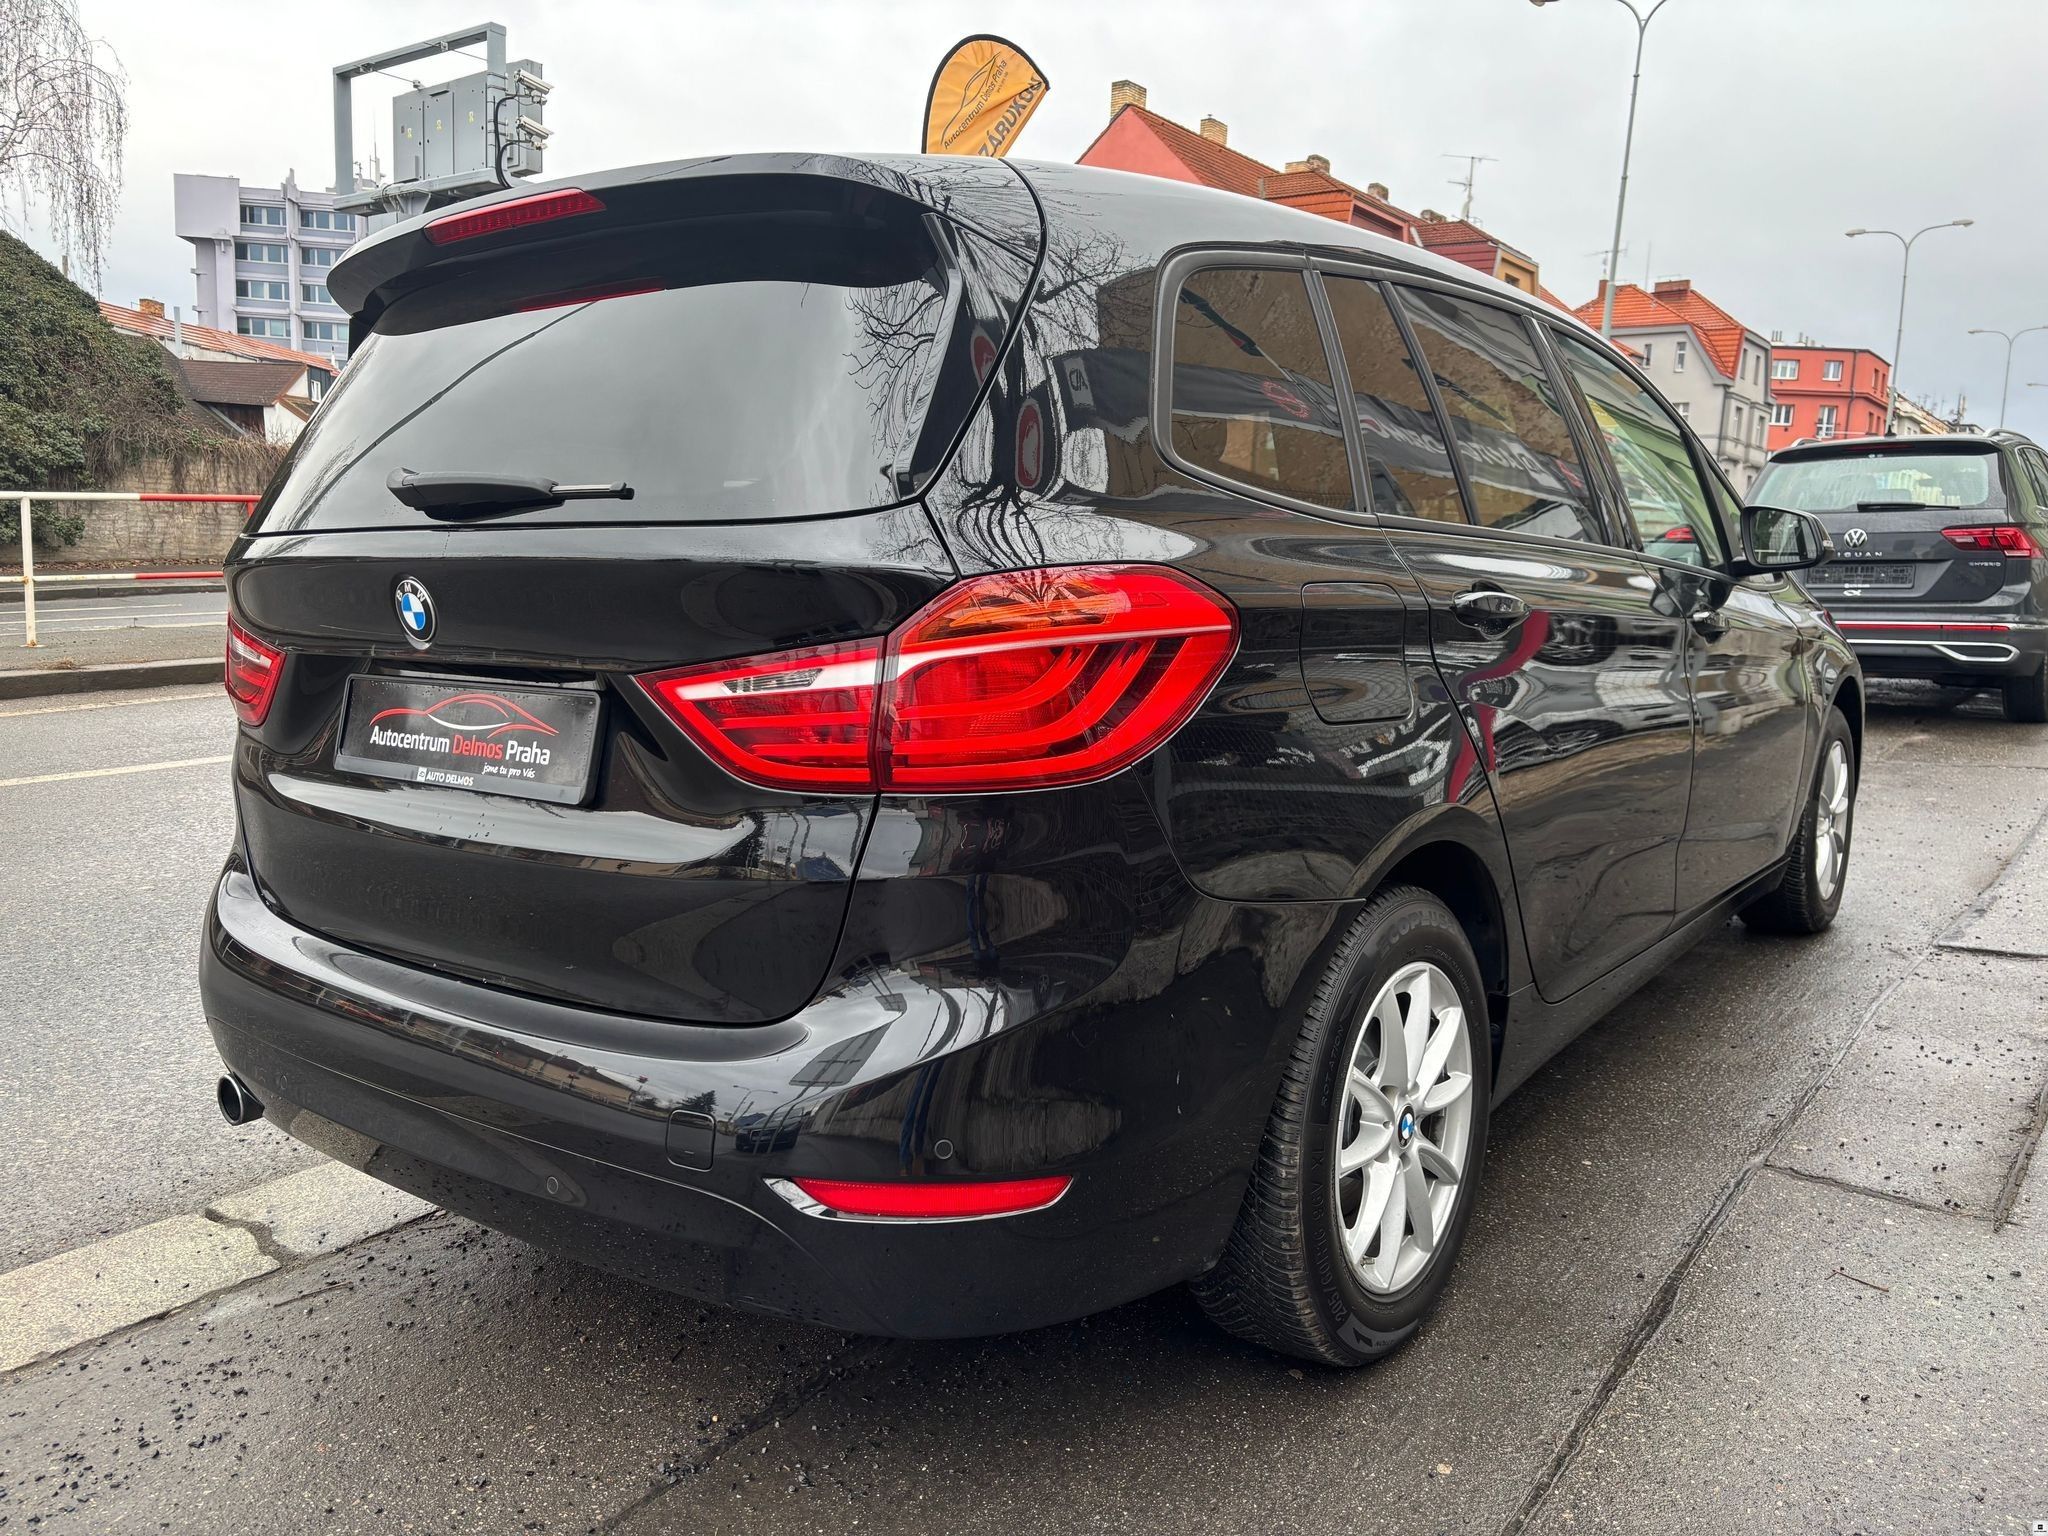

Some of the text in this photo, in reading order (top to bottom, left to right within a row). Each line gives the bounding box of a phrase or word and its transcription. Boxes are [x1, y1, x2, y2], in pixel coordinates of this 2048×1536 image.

[943, 100, 984, 149] Autocentrum
[992, 59, 1008, 85] Praha
[396, 582, 426, 602] BMW
[370, 725, 551, 765] Autocentrum Delmos Praha
[426, 772, 474, 787] AUTO DELMOS
[482, 762, 536, 779] jsme tu pro Vás
